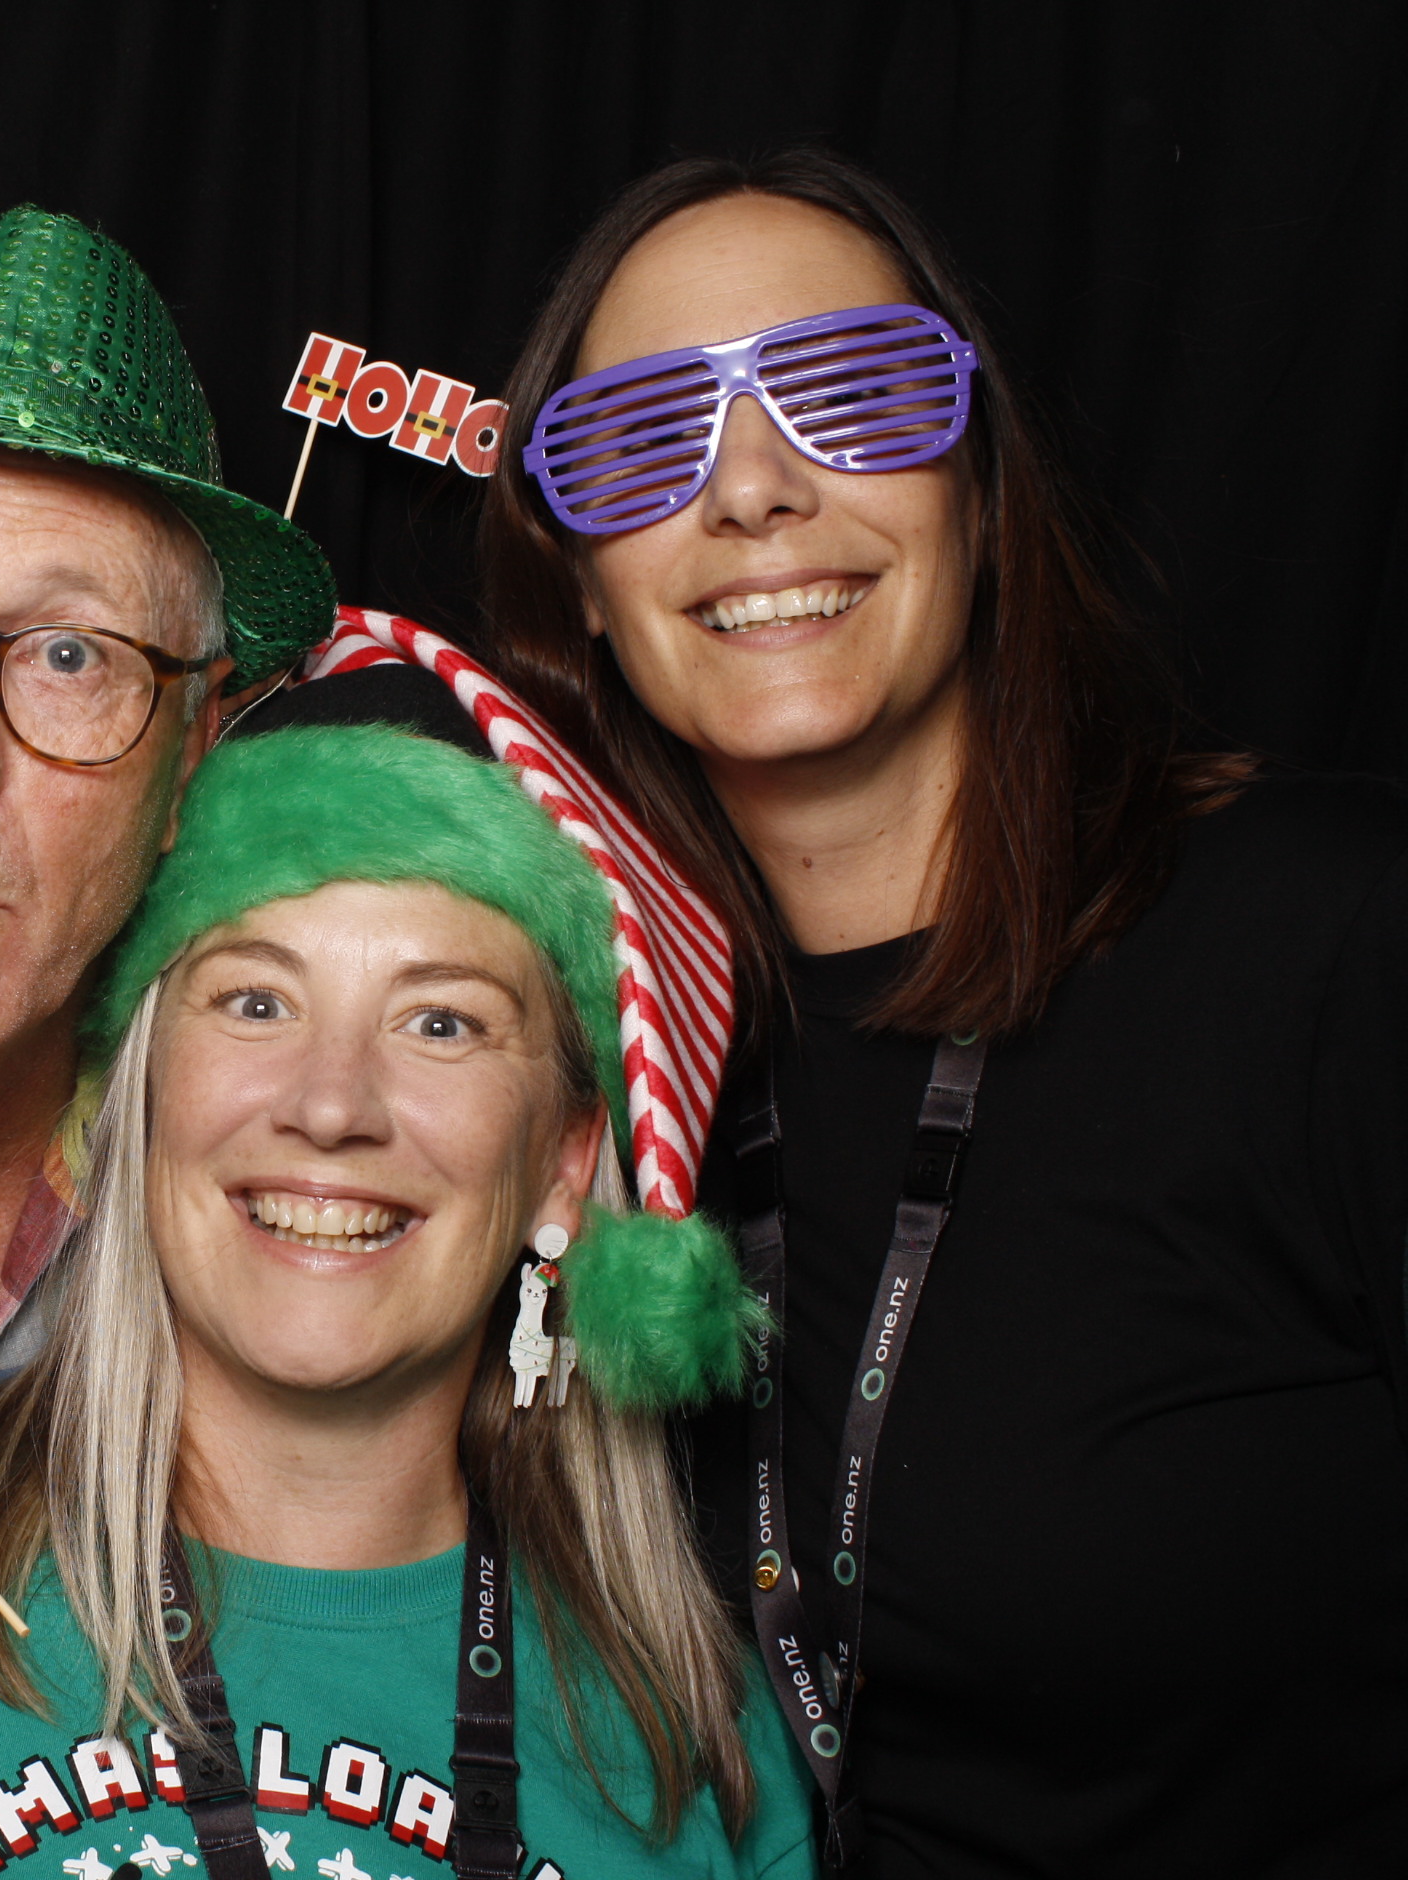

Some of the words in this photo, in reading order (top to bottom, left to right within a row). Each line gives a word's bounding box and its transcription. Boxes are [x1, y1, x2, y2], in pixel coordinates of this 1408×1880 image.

[282, 332, 509, 477] HOHO
[874, 1276, 909, 1362] one.nz
[757, 1458, 772, 1544] one.nz
[841, 1455, 862, 1545] one.nz
[478, 1554, 494, 1640] one.nz
[778, 1634, 823, 1720] one.nz
